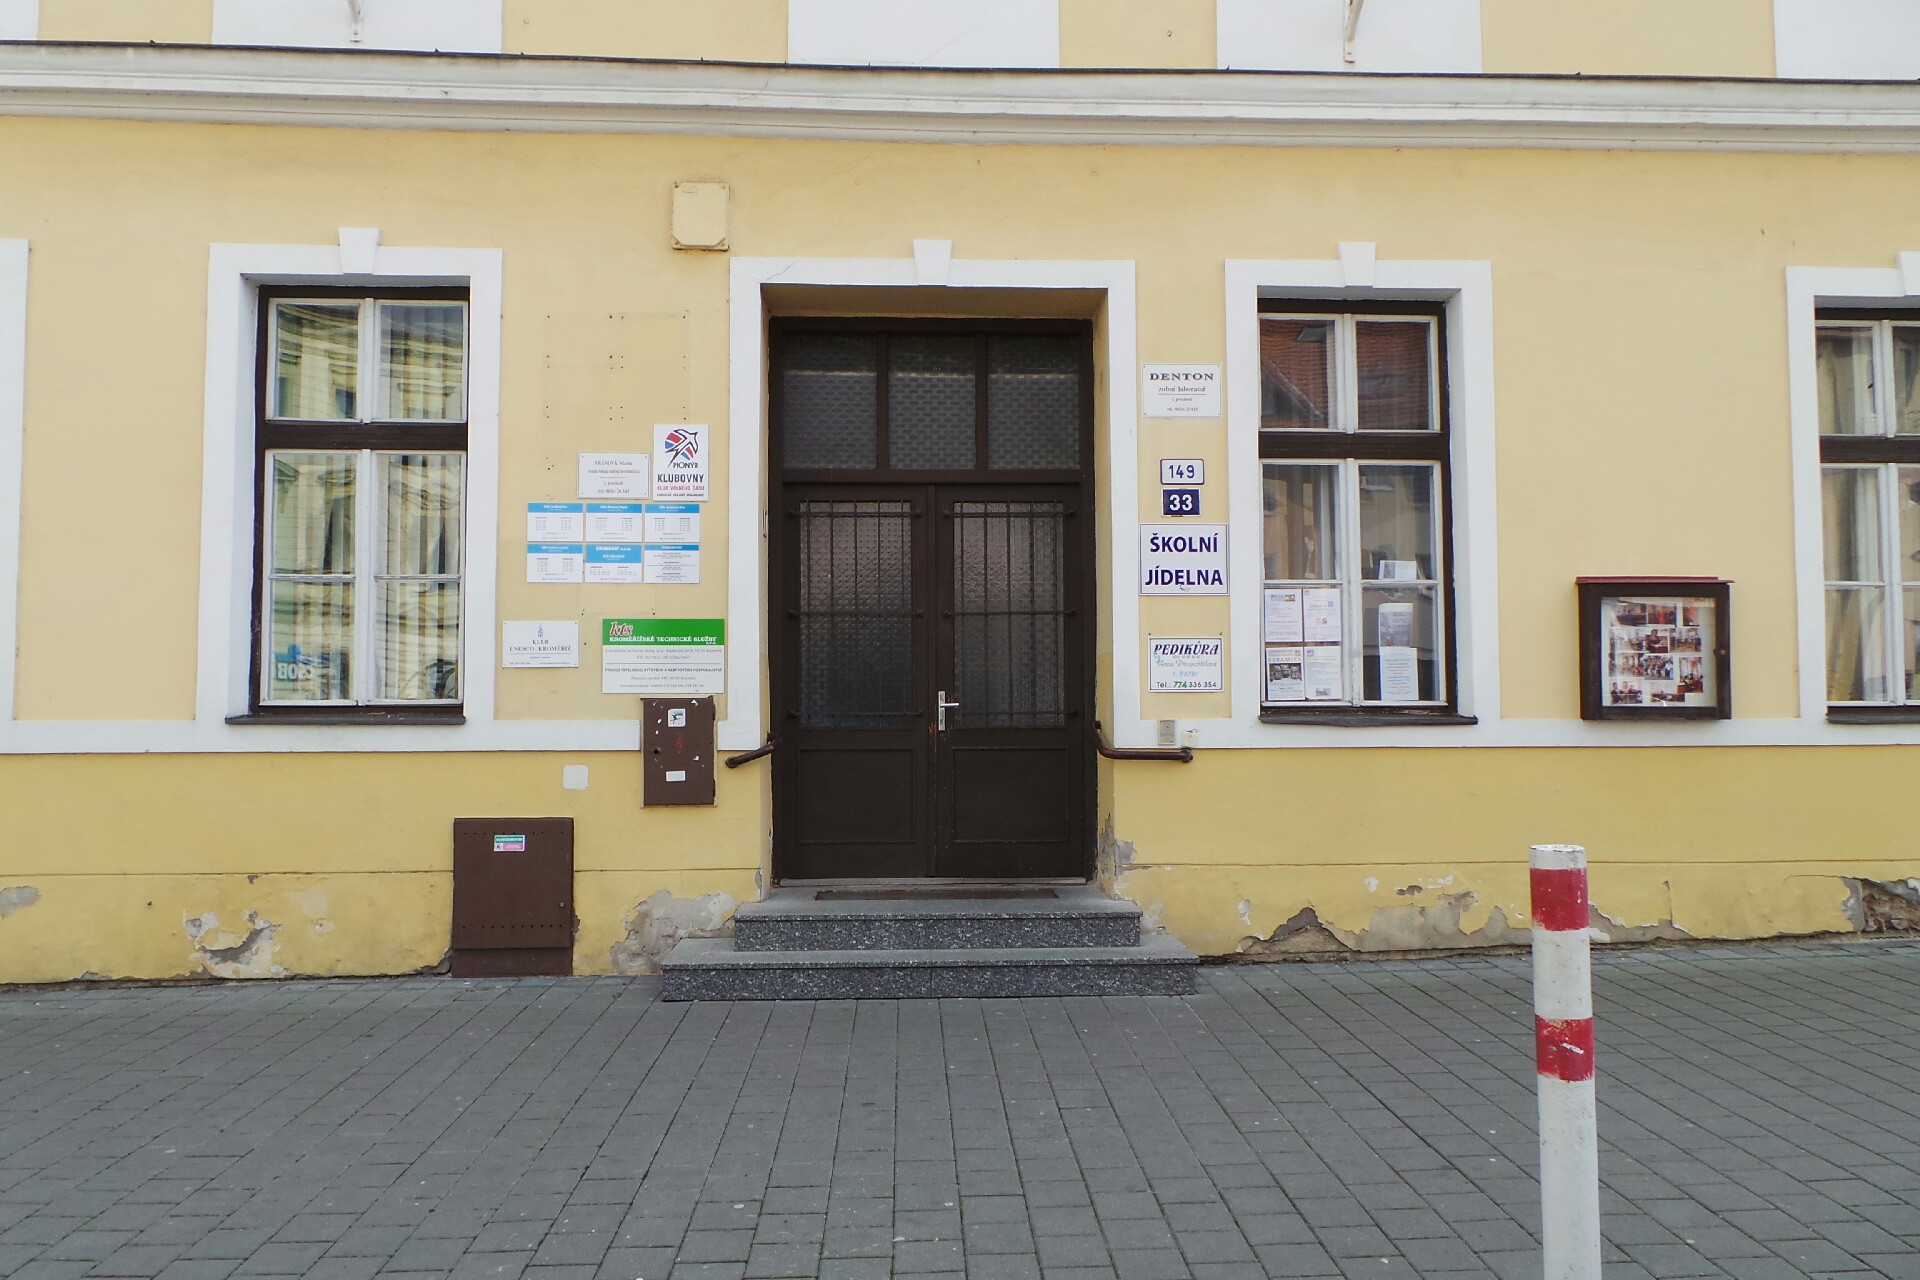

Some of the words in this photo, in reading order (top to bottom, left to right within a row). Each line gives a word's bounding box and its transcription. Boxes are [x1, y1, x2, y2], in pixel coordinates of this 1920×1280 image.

[1149, 372, 1214, 381] DENTON
[672, 461, 699, 469] PIONÝR
[1168, 464, 1195, 479] 149
[657, 473, 705, 483] KLUBOVNY
[1169, 494, 1193, 511] 33
[1149, 532, 1219, 553] ŠKOLNÍ
[1144, 565, 1224, 586] JÍDELNA
[609, 621, 634, 636] kts
[1154, 641, 1219, 655] PEDIKÚRA
[1173, 680, 1187, 689] 774
